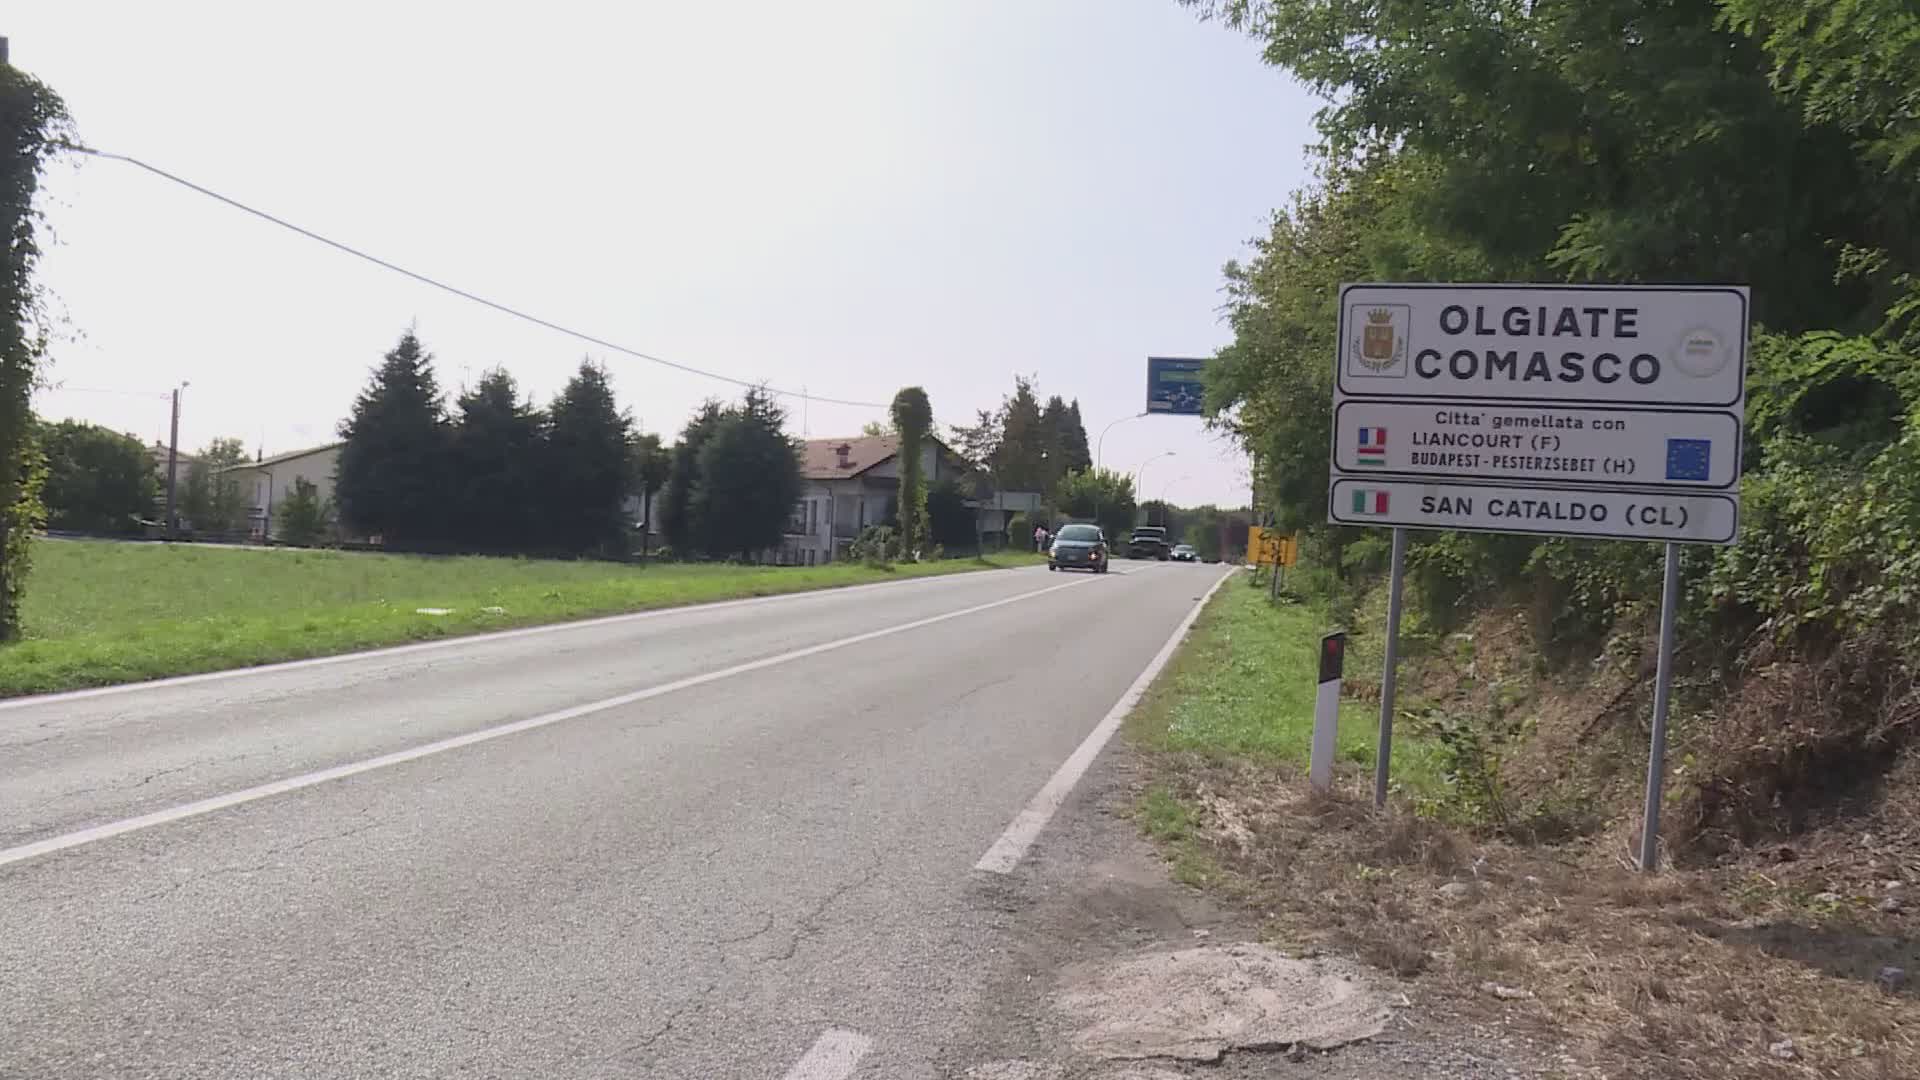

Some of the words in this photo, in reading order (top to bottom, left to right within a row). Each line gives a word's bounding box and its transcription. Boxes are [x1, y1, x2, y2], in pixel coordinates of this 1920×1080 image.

[1440, 305, 1638, 338] OLGIATE
[1415, 349, 1661, 384] COMASCO
[1492, 414, 1583, 430] gemellata
[1592, 419, 1625, 431] con
[1413, 432, 1522, 449] LIANCOURT
[1531, 435, 1560, 452] (F)
[1603, 458, 1635, 474] (H)
[1420, 496, 1473, 515] SAN
[1487, 500, 1607, 522] CATALDO
[1625, 505, 1688, 528] (CL)
